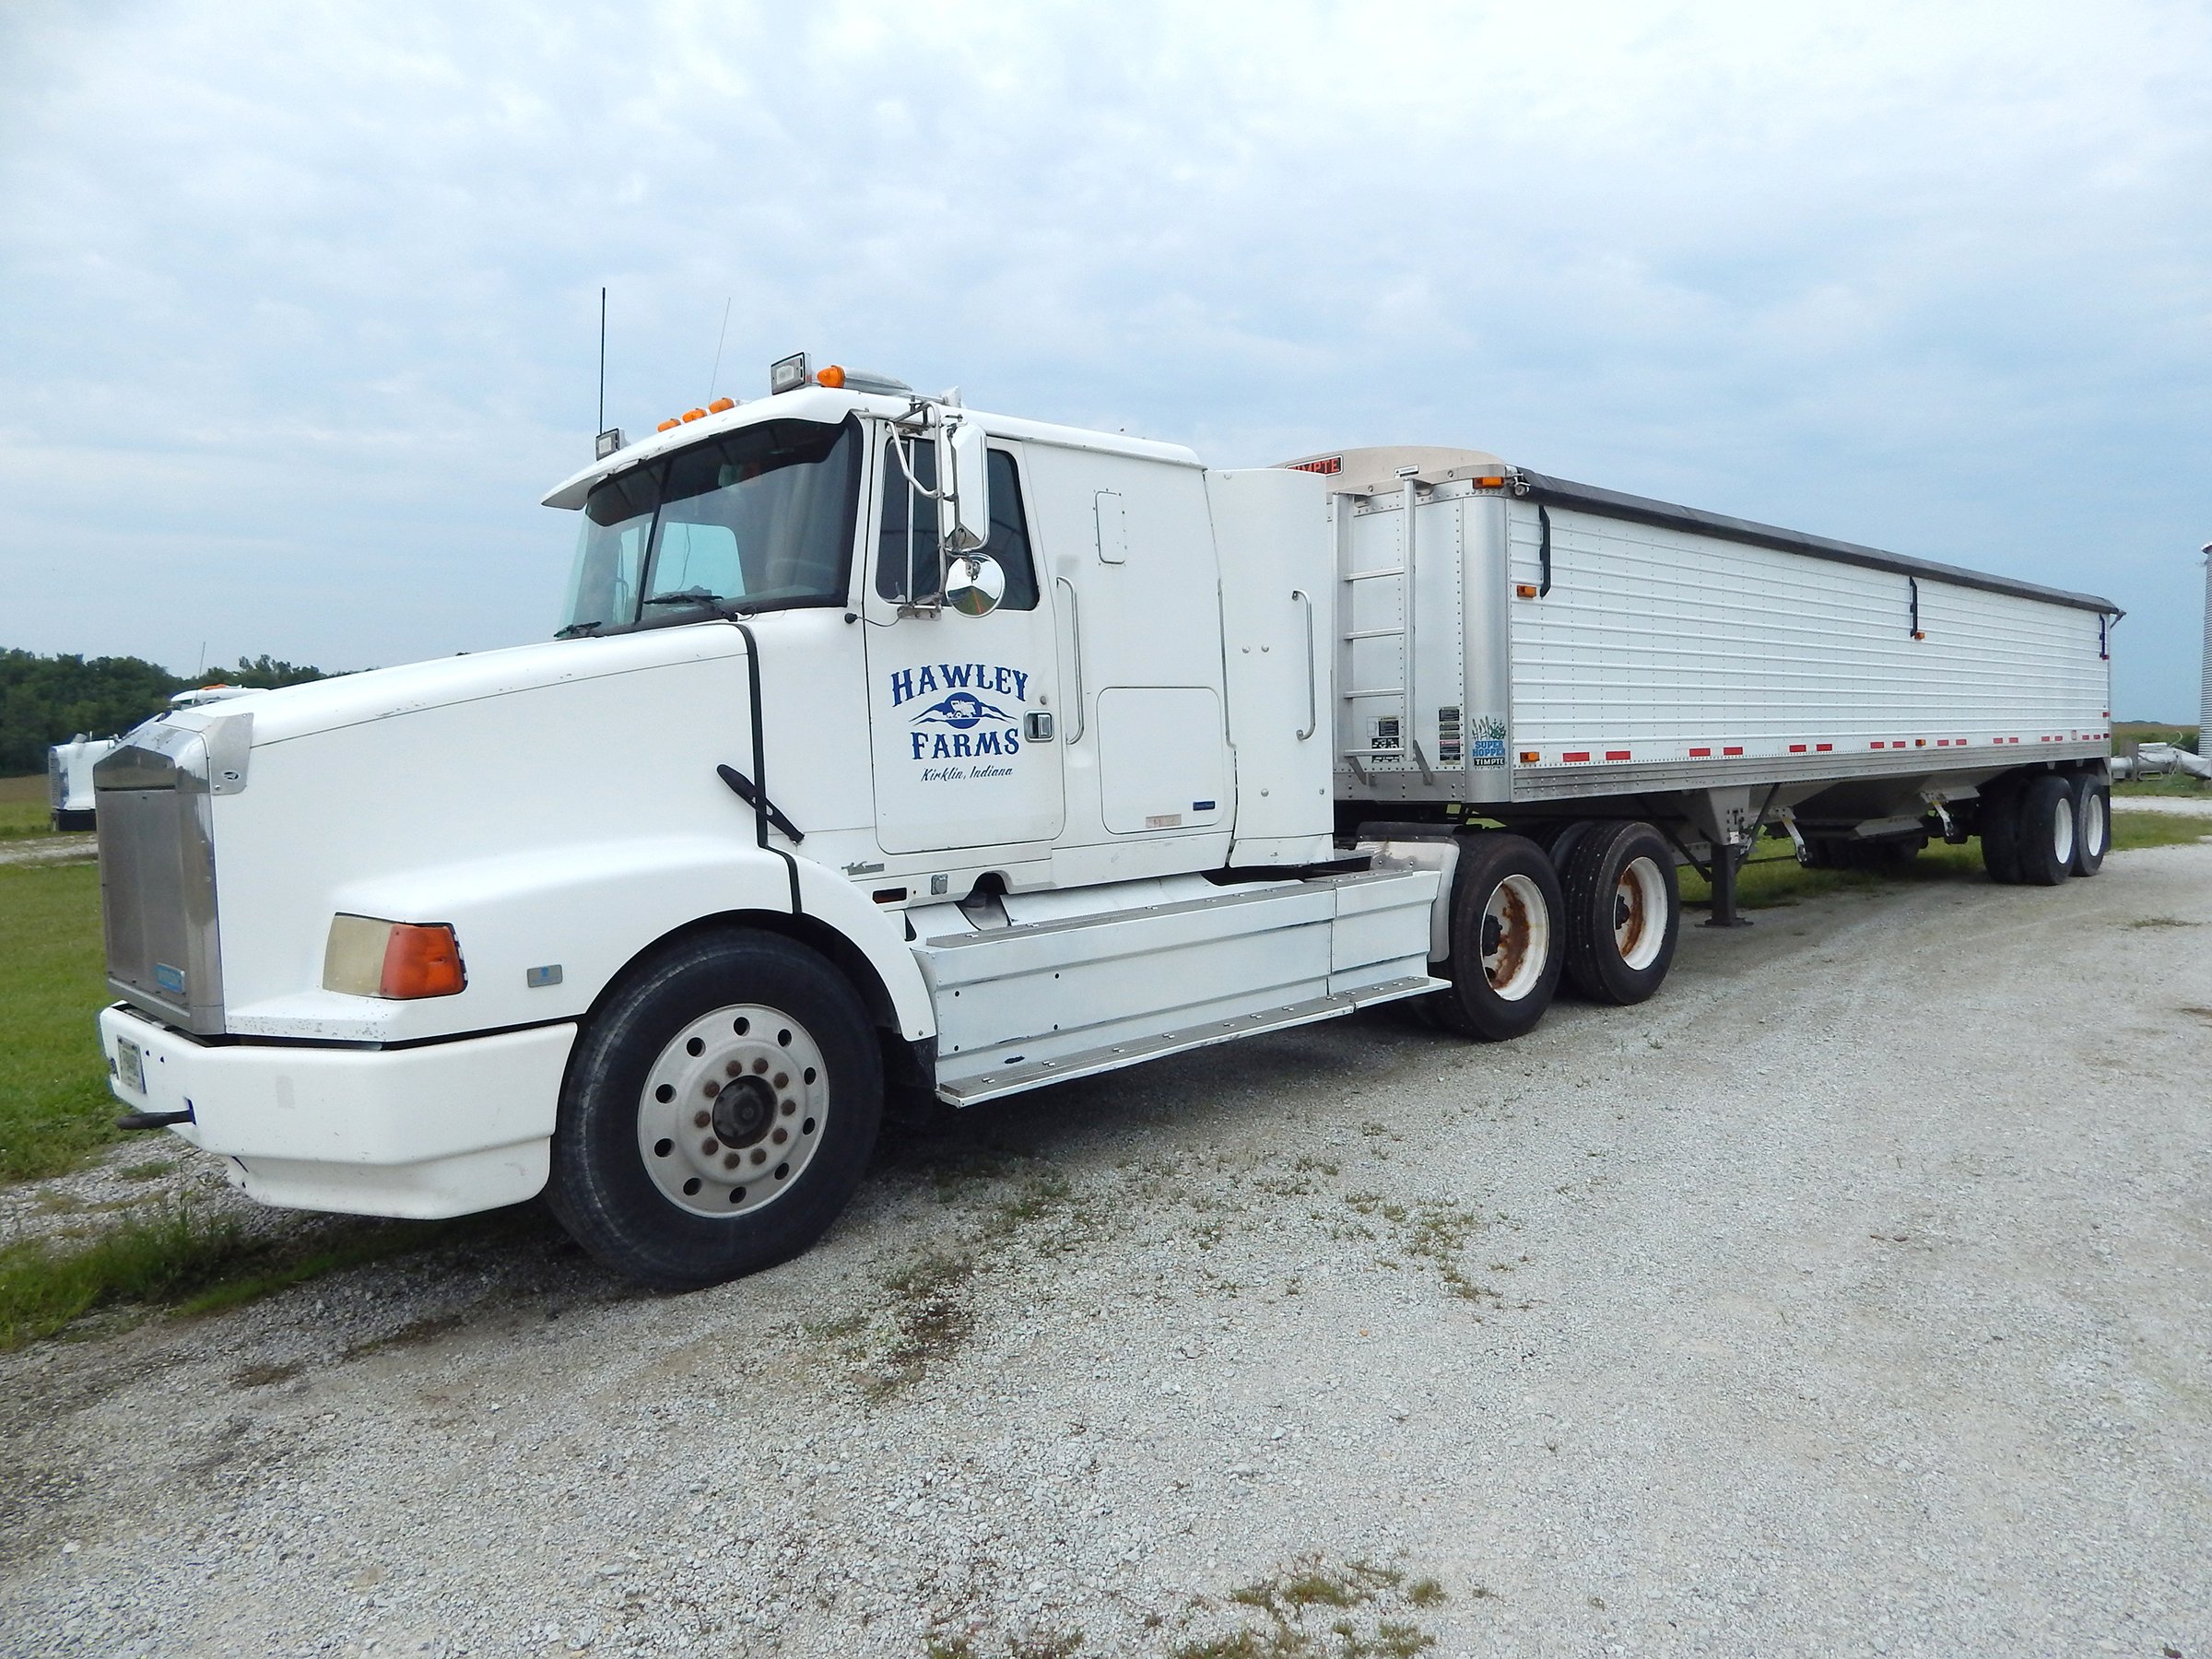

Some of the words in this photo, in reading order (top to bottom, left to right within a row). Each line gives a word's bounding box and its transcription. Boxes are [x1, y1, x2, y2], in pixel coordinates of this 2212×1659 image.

[1288, 458, 1339, 473] MPTE
[890, 664, 1029, 707] HAWLEY
[910, 728, 1019, 760] FARMS
[1473, 747, 1505, 757] HOPPER
[1475, 740, 1503, 748] SUPER
[921, 767, 967, 782] Kirklin,
[970, 765, 1013, 778] Indiana
